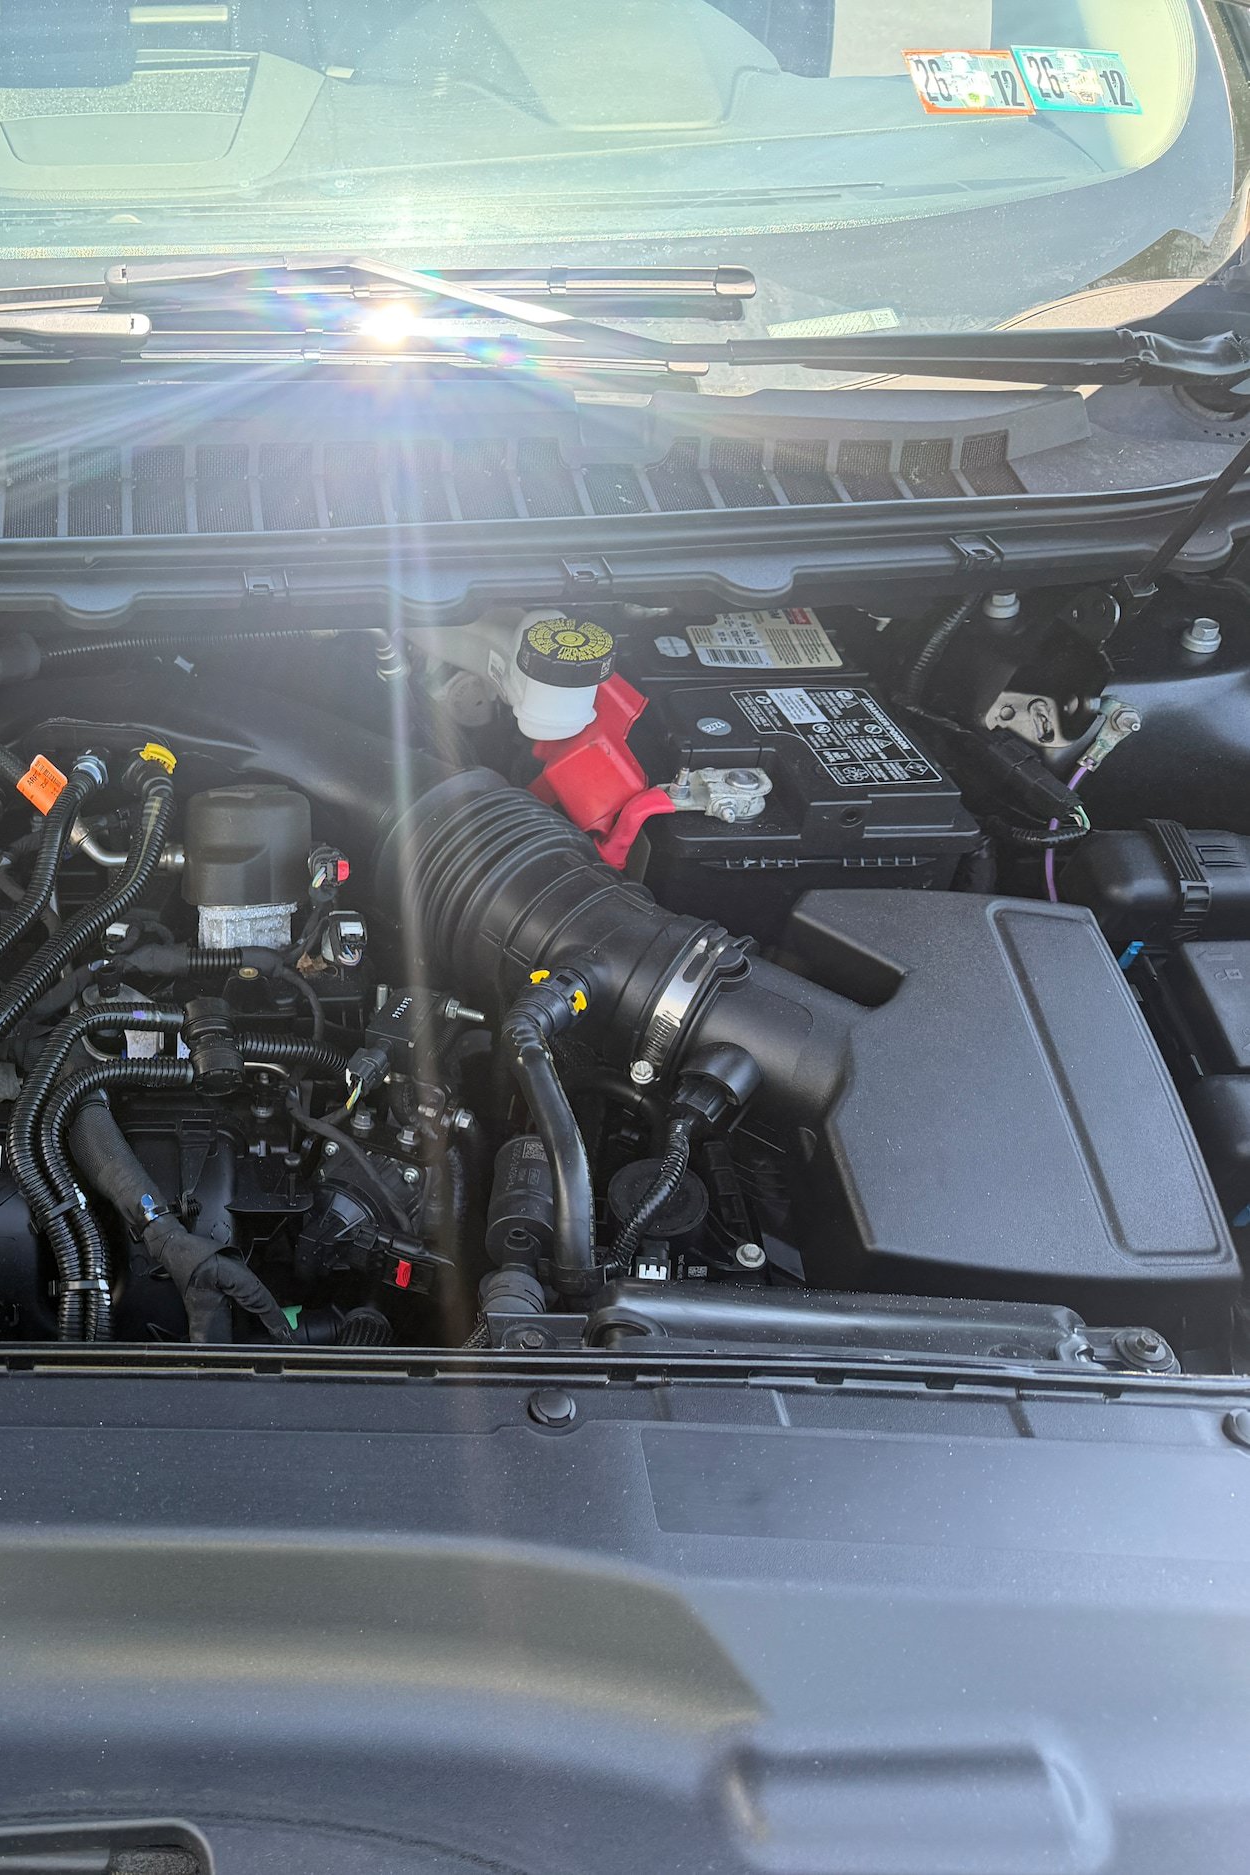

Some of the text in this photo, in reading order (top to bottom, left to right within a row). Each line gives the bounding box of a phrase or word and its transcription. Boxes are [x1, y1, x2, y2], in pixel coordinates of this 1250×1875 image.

[914, 59, 1026, 106] 26 12
[1028, 55, 1134, 107] 26 12
